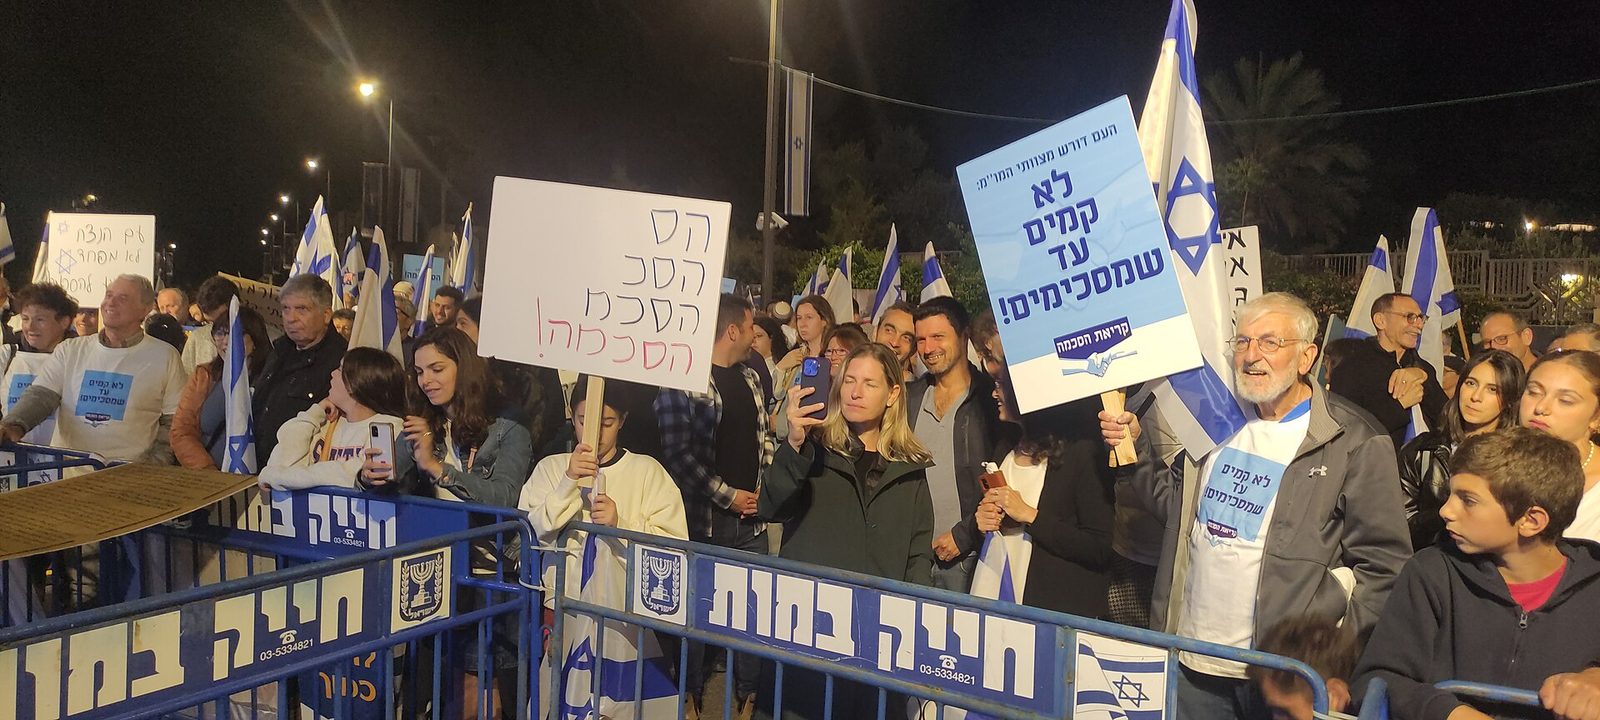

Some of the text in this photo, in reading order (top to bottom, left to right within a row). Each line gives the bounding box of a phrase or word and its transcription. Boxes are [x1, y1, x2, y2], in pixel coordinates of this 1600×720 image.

[1057, 135, 1089, 156] דורש
[1091, 123, 1118, 143] העם
[1016, 149, 1055, 172] מצוותי
[1031, 168, 1073, 208] לא
[650, 208, 711, 253] הס
[1022, 197, 1099, 246] קמים
[1048, 237, 1090, 270] עד
[622, 254, 705, 296] הסכ
[998, 247, 1165, 325] שמסכימים!
[536, 296, 693, 375] הסכמה!
[1056, 322, 1129, 353] קריאת הסכמה
[89, 379, 124, 389] לא קמים
[1221, 463, 1271, 488] לא קמים
[1233, 481, 1248, 494] עד
[1204, 486, 1264, 515] שמסכימים!
[308, 493, 397, 549] חייק
[333, 536, 365, 548] 03-5334821
[212, 568, 364, 682] חייק
[708, 562, 1036, 699] חייק במות
[260, 638, 313, 661] 03-5334821
[919, 664, 975, 685] 03-5334821
